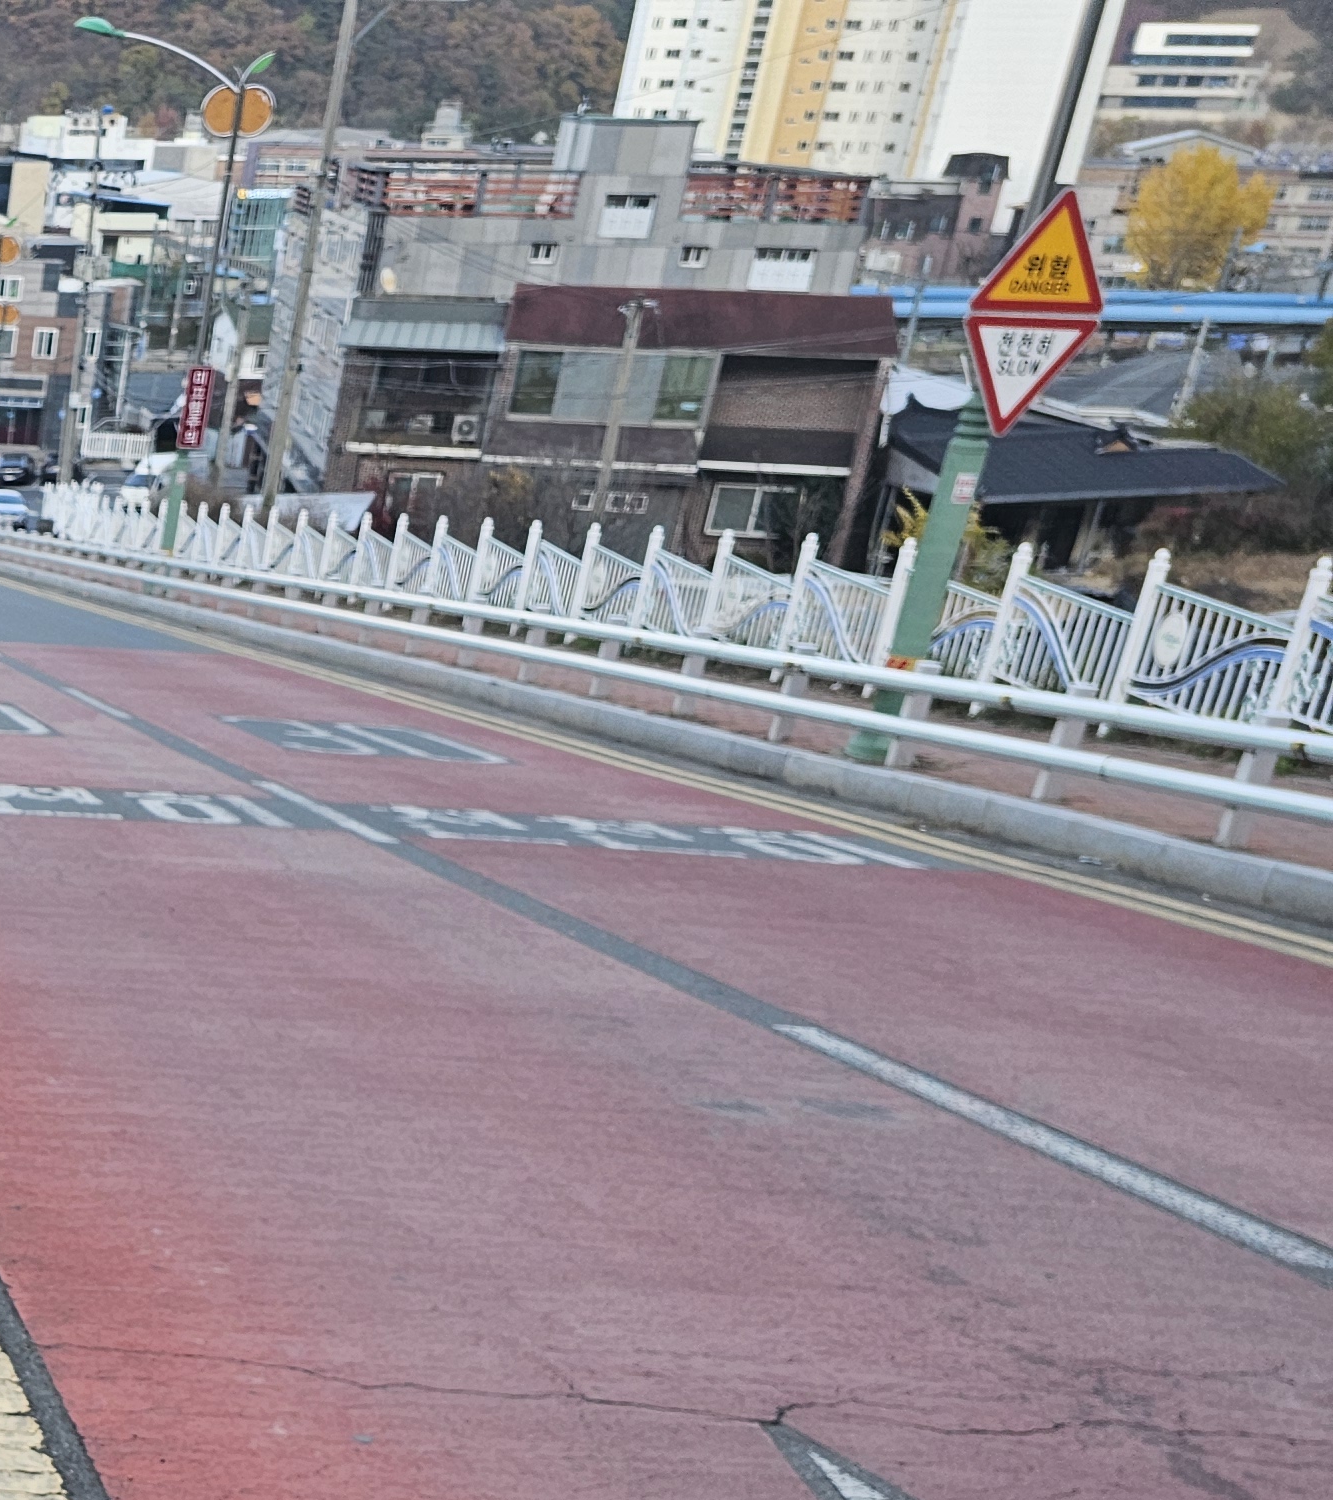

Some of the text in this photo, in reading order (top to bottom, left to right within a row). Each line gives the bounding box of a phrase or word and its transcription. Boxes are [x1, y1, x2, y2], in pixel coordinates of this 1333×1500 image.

[1023, 254, 1072, 279] 위험
[1008, 279, 1071, 295] DANGER
[997, 332, 1054, 358] 천천히
[995, 359, 1041, 377] SLOW
[368, 804, 931, 870] 천천히
